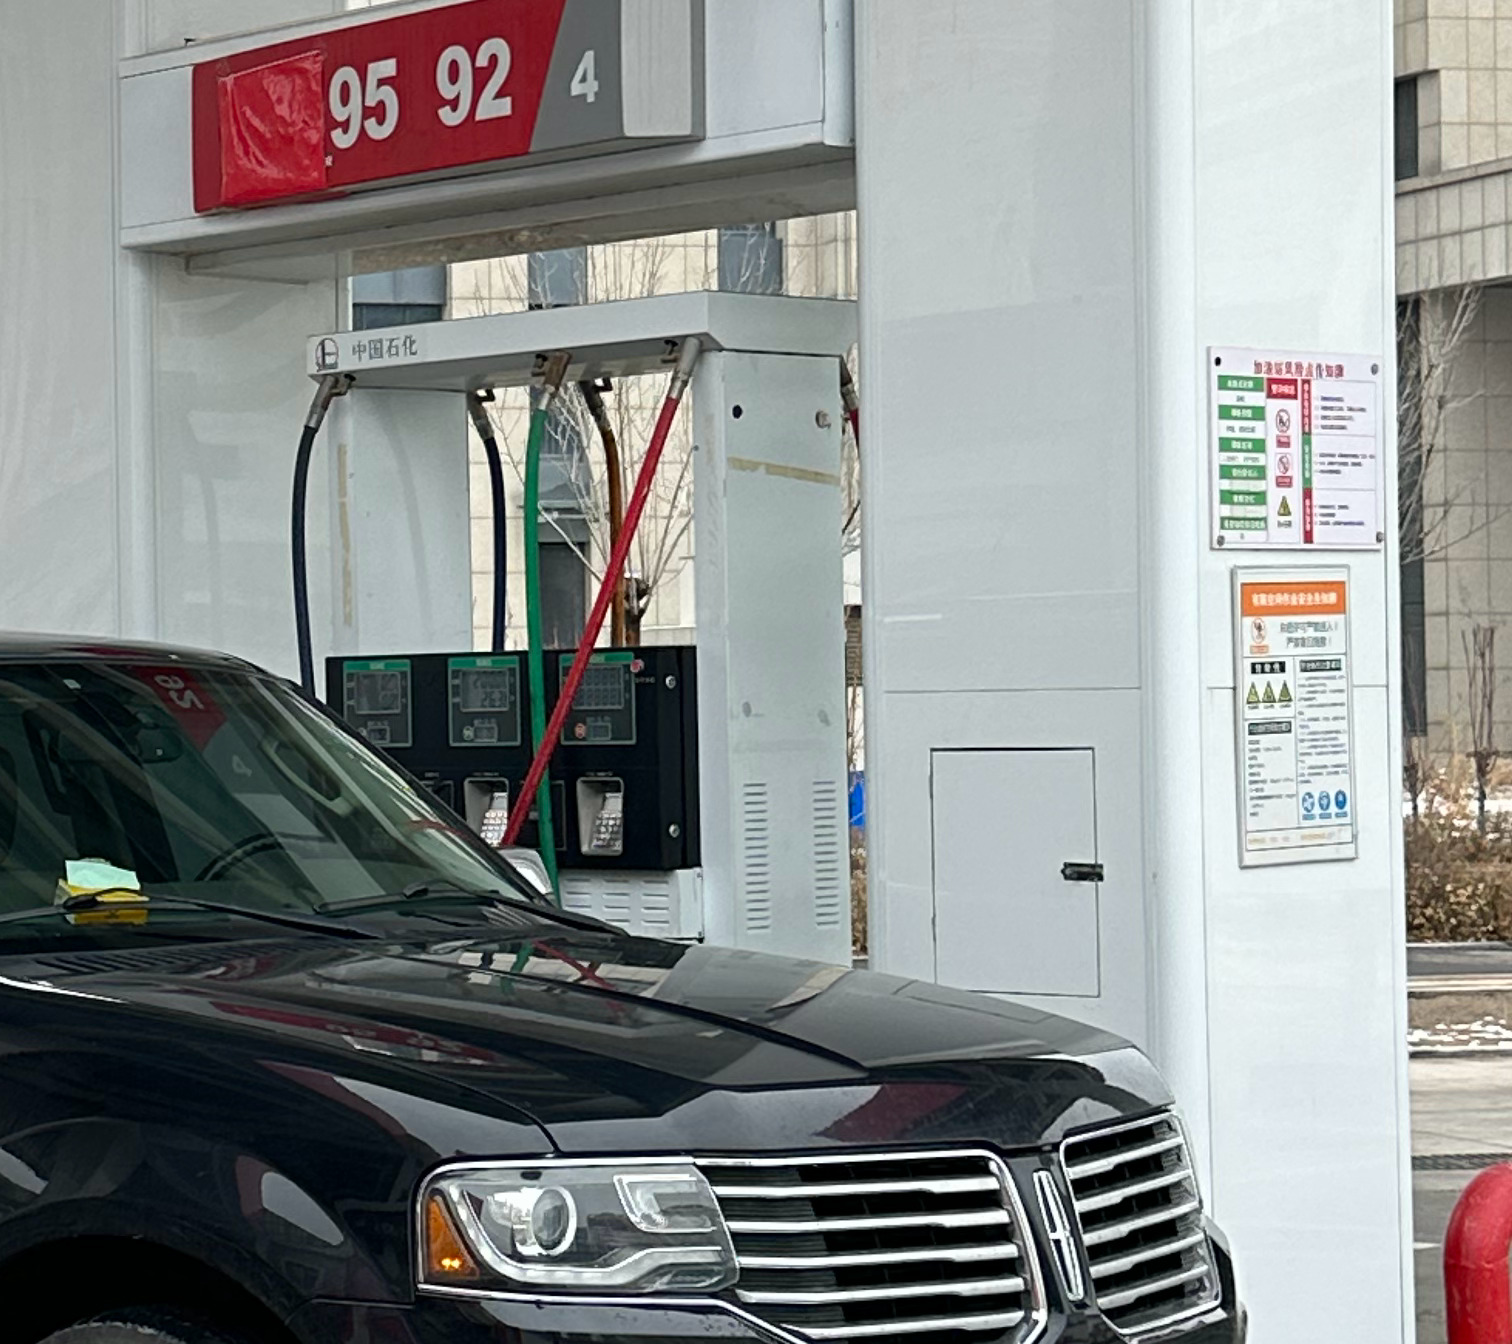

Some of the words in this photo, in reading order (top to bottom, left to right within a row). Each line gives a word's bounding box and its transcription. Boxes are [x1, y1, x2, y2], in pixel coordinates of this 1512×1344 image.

[329, 58, 399, 150] 95
[436, 37, 513, 127] 92
[569, 50, 599, 103] 4
[352, 335, 418, 362] 中国石化
